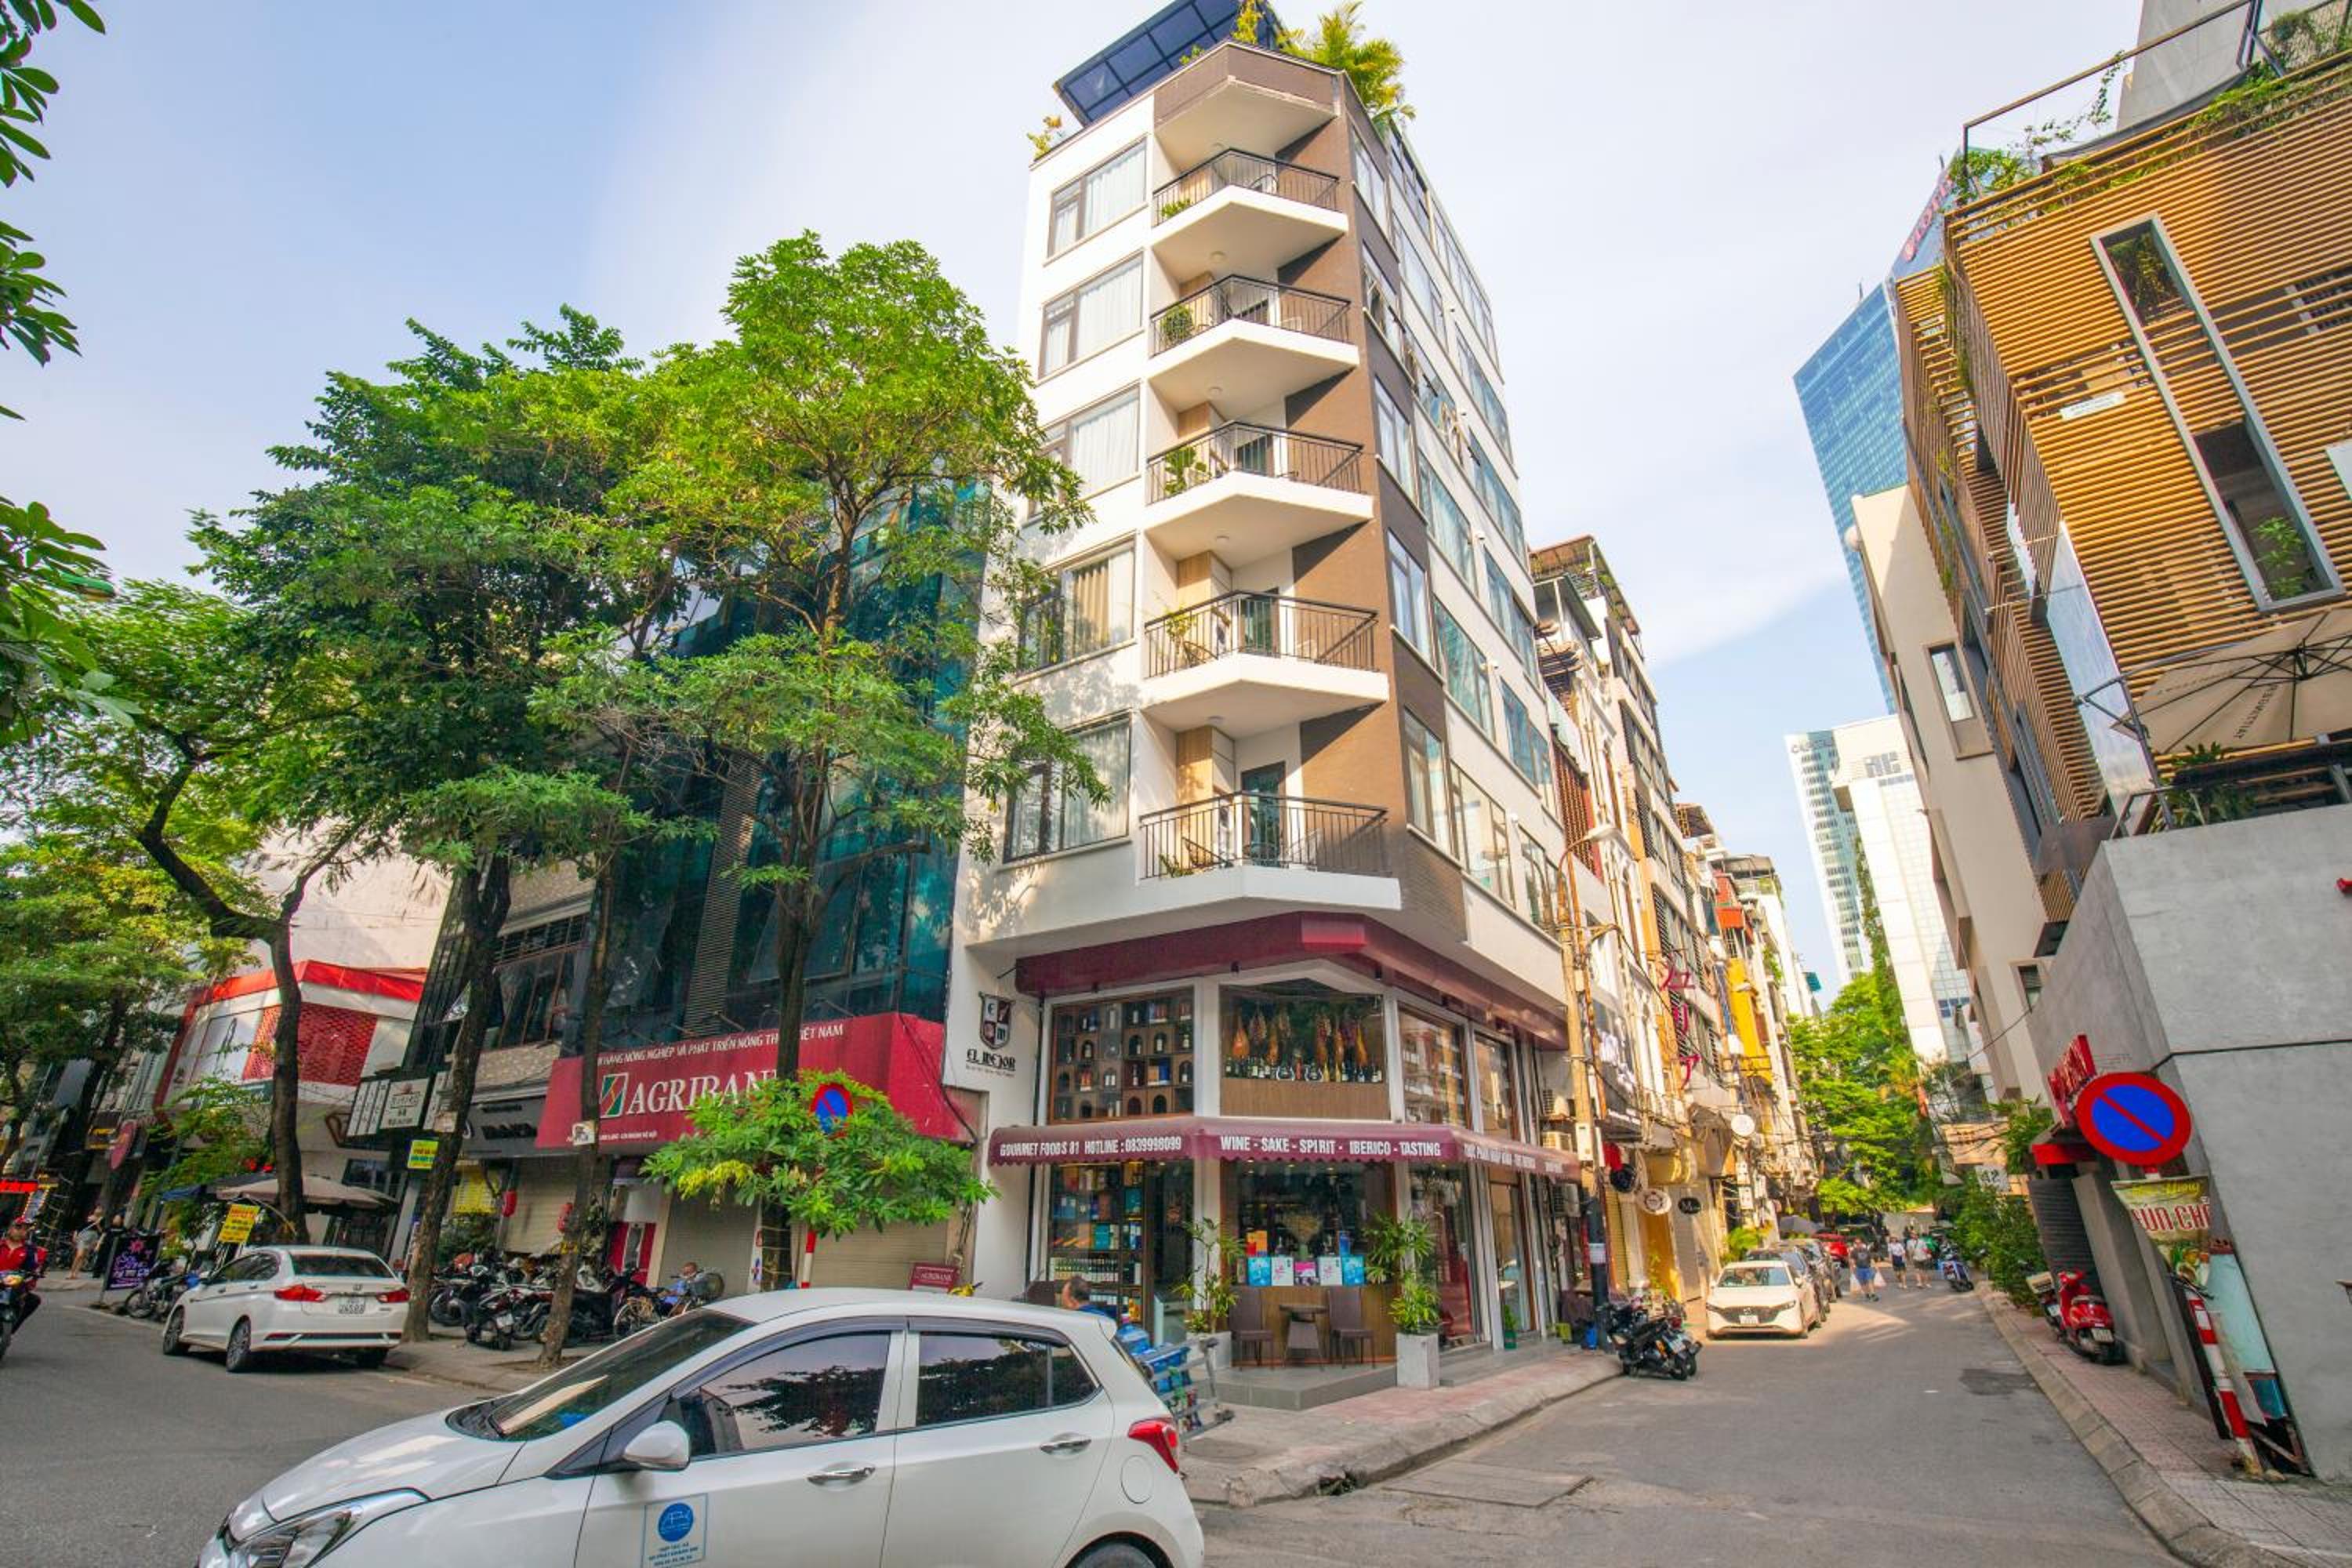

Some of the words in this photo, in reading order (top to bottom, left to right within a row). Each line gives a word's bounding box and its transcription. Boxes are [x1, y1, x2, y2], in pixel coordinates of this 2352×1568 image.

[818, 1023, 844, 1039] NAM
[1000, 1142, 1038, 1156] GOURMET
[1040, 1141, 1067, 1155] FOODS
[1084, 1138, 1119, 1155] HOTLINE
[1220, 1136, 1250, 1151] WINE
[1261, 1137, 1290, 1152] SAKE
[1299, 1138, 1336, 1154] SPIRIT
[1349, 1140, 1392, 1156] IBERICO
[1399, 1141, 1441, 1156] TASTING
